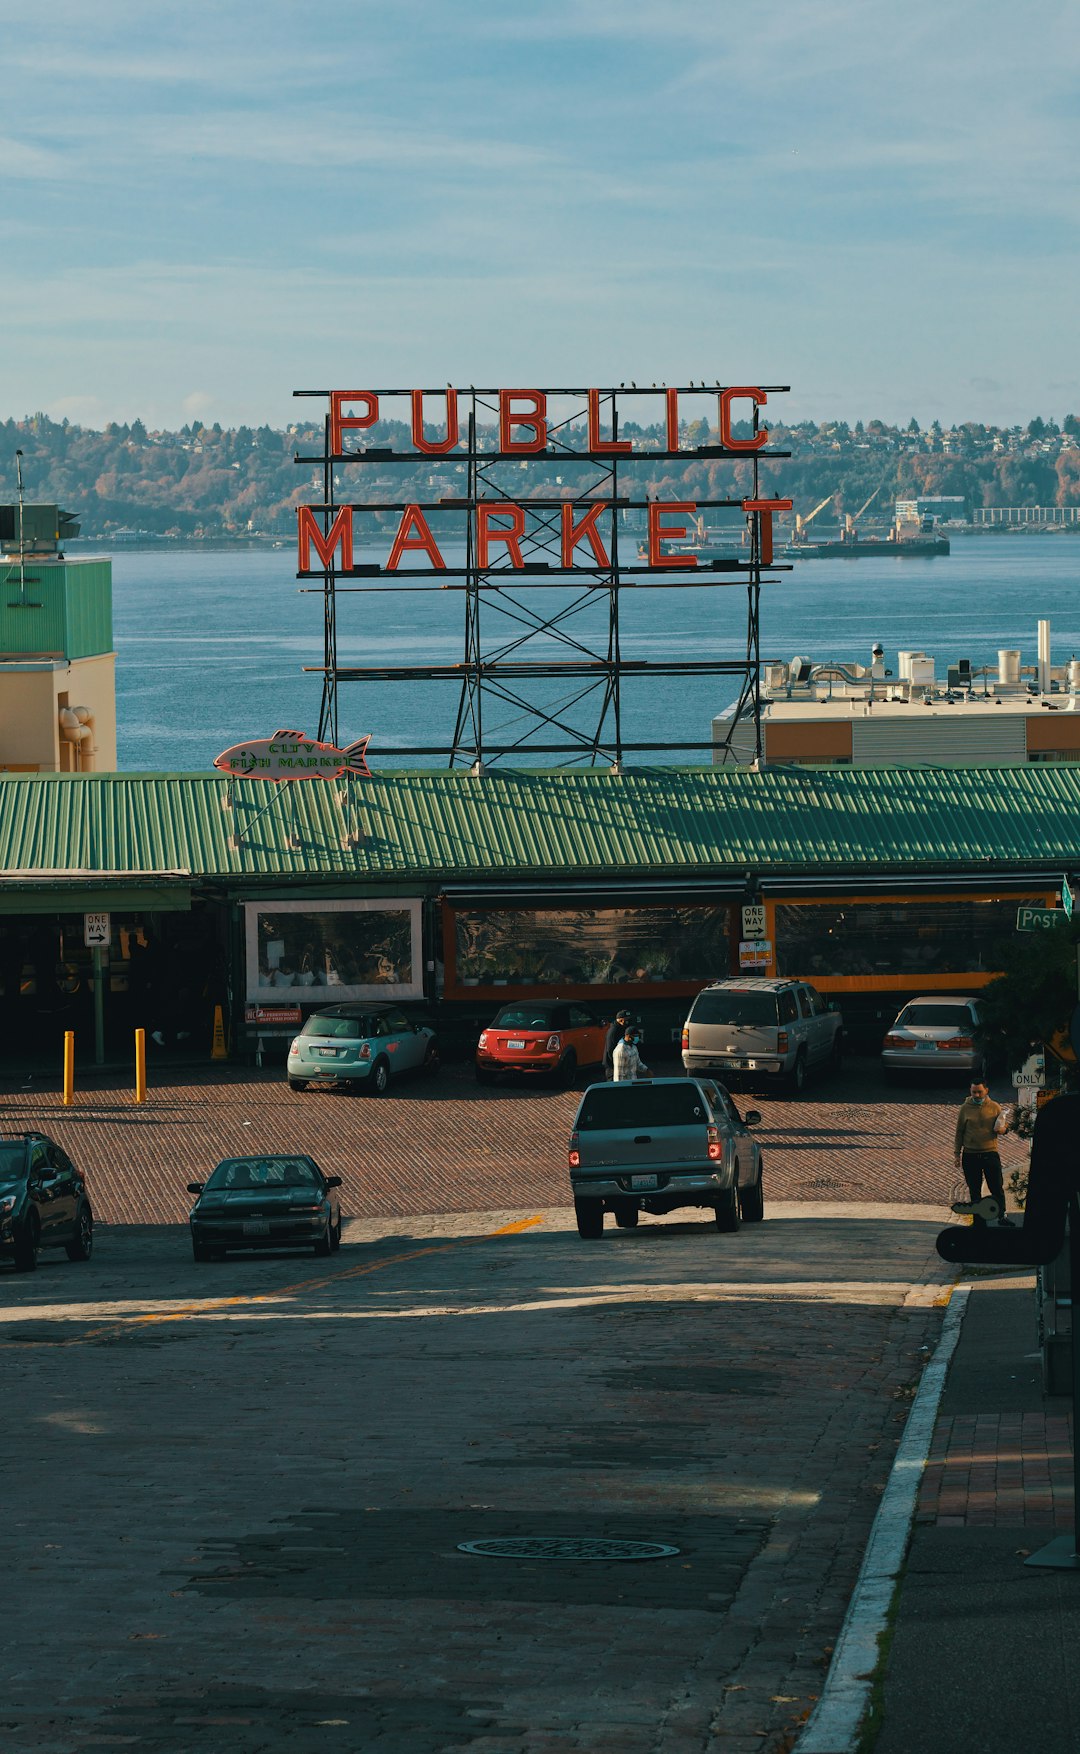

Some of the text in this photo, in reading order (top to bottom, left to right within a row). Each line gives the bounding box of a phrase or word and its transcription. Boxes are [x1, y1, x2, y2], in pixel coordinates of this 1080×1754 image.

[330, 386, 768, 456] PUBLIC
[298, 499, 793, 571] MARKET
[269, 744, 316, 754] CITY
[230, 756, 352, 768] FISH MARKET
[744, 908, 763, 916] ONE
[88, 915, 107, 924] ONE
[744, 917, 763, 925] WAY
[1022, 910, 1059, 929] Post
[88, 924, 107, 932] WAY
[1016, 1074, 1041, 1084] ONLY
